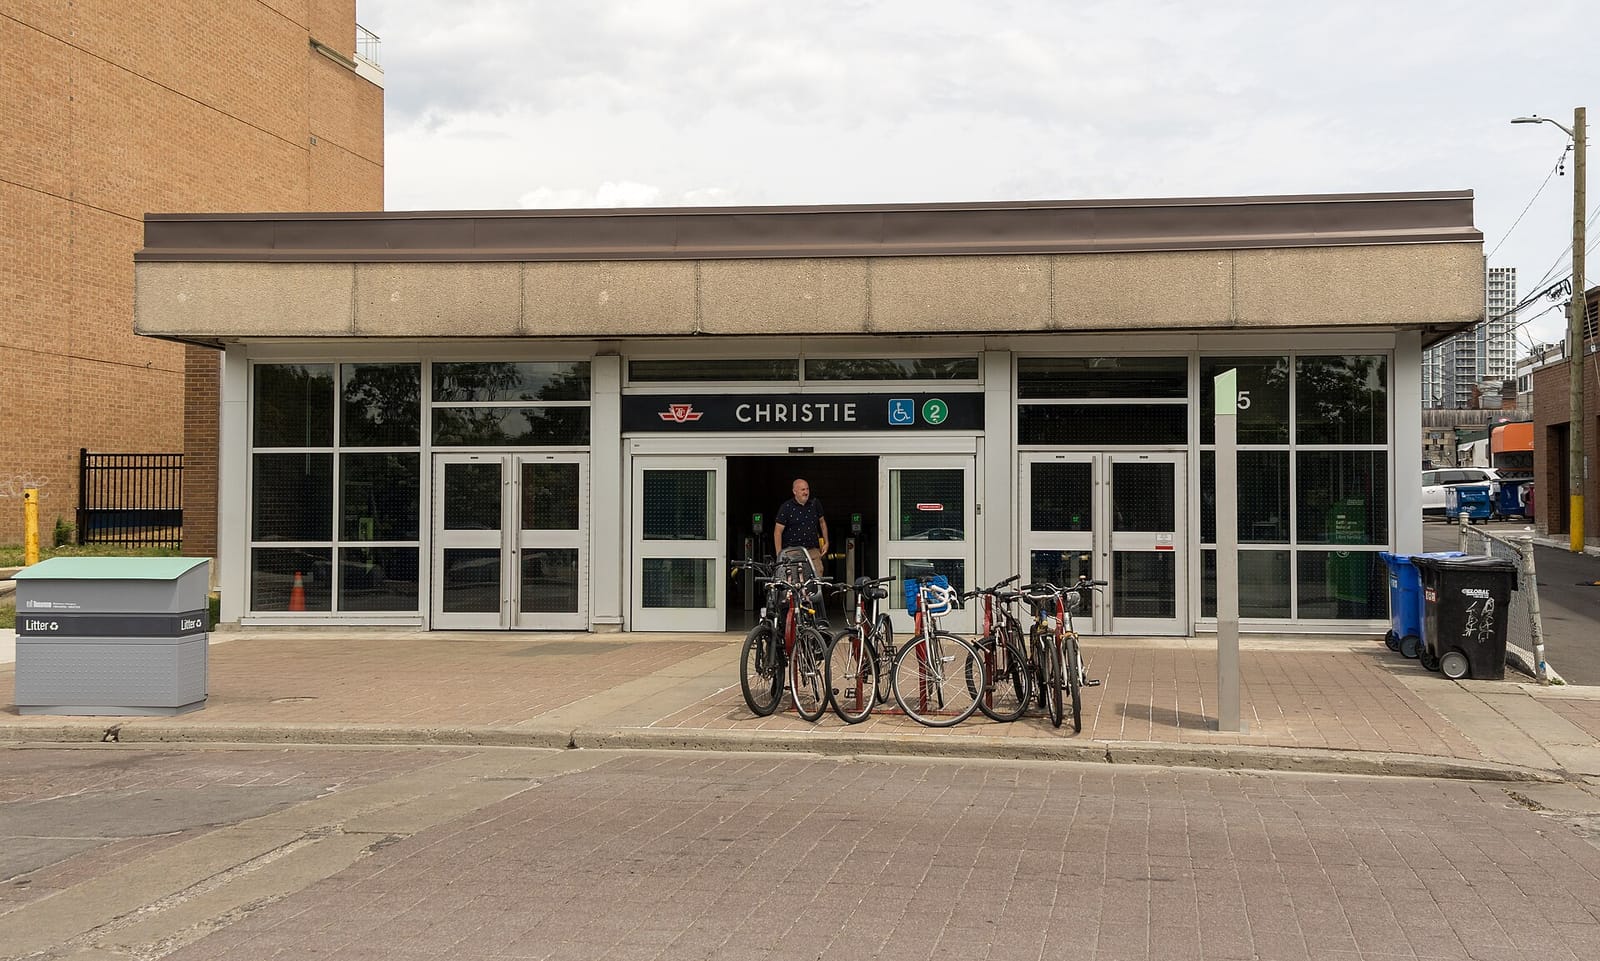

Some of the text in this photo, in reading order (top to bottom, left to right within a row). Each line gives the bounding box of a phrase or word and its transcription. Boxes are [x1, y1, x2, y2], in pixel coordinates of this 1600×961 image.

[1237, 390, 1251, 410] 5
[735, 403, 857, 423] CHRISTIE
[929, 404, 941, 419] 2
[25, 619, 49, 631] Litter
[181, 619, 196, 631] Litter
